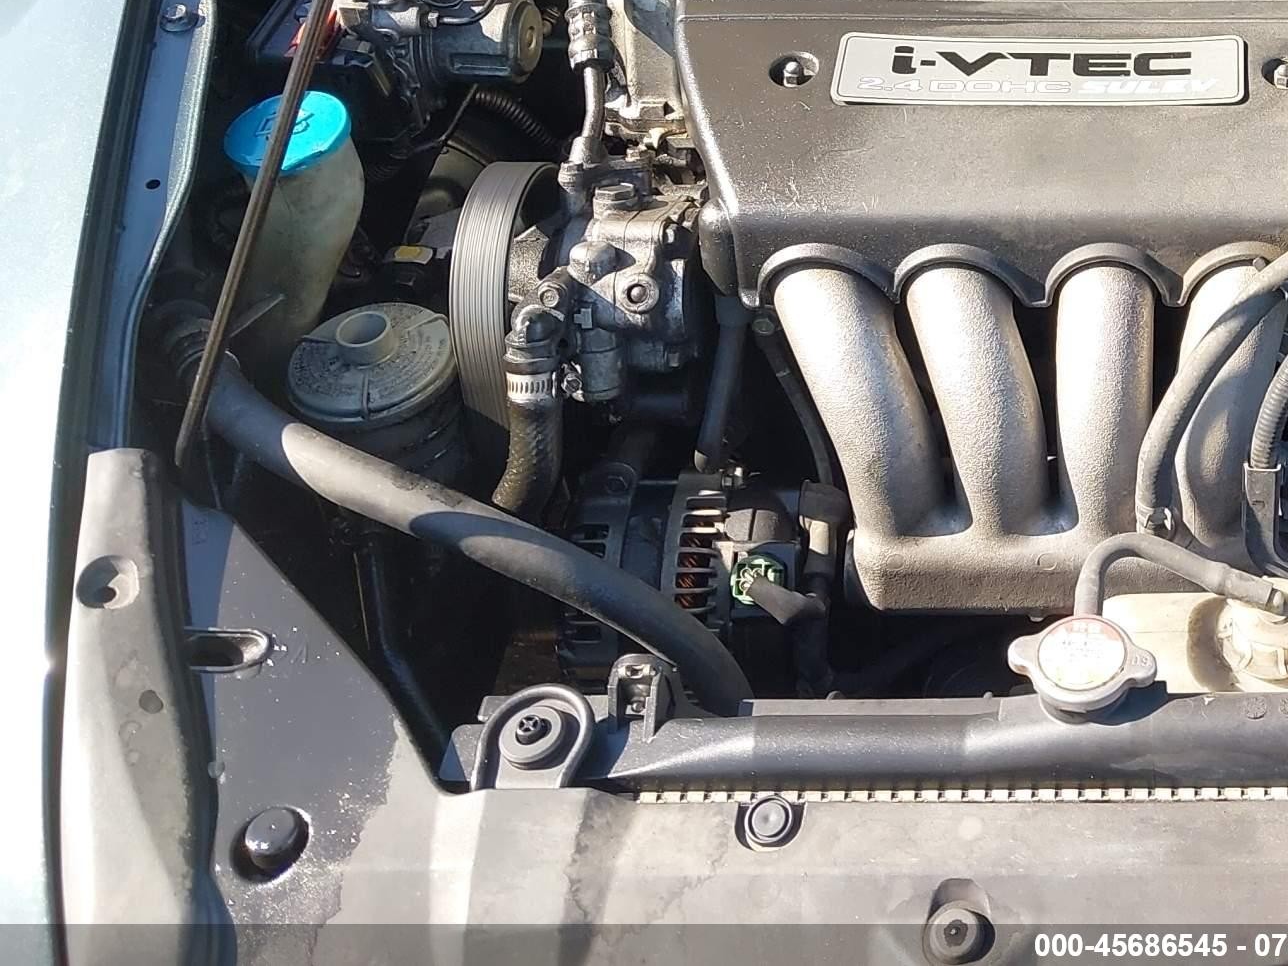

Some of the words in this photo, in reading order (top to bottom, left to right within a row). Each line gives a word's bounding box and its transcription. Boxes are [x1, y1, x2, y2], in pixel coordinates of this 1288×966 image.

[891, 45, 1192, 77] i-VTEC
[857, 77, 923, 92] 2.4
[929, 79, 1071, 94] DOHC
